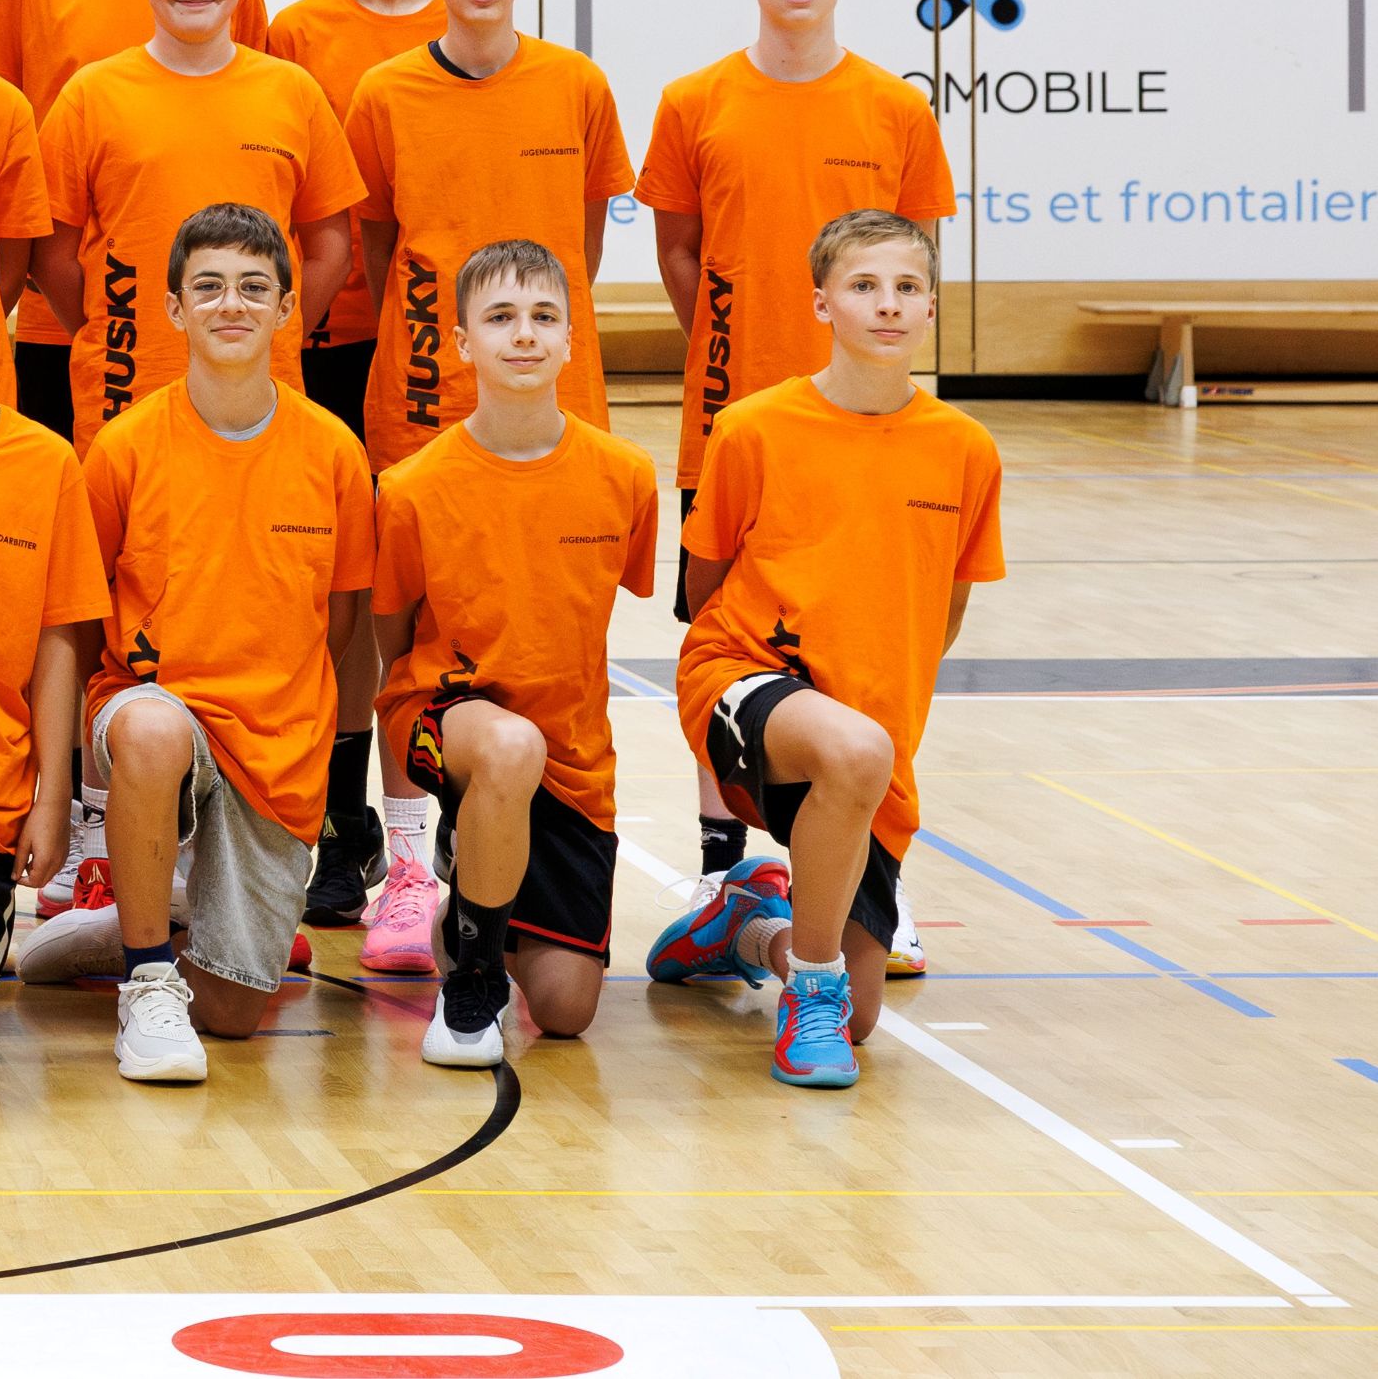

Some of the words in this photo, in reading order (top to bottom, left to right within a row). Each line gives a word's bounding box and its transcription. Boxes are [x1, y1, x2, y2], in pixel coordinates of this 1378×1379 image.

[1047, 183, 1102, 223] et
[1119, 179, 1376, 223] frontalier
[406, 260, 441, 429] HUSKY
